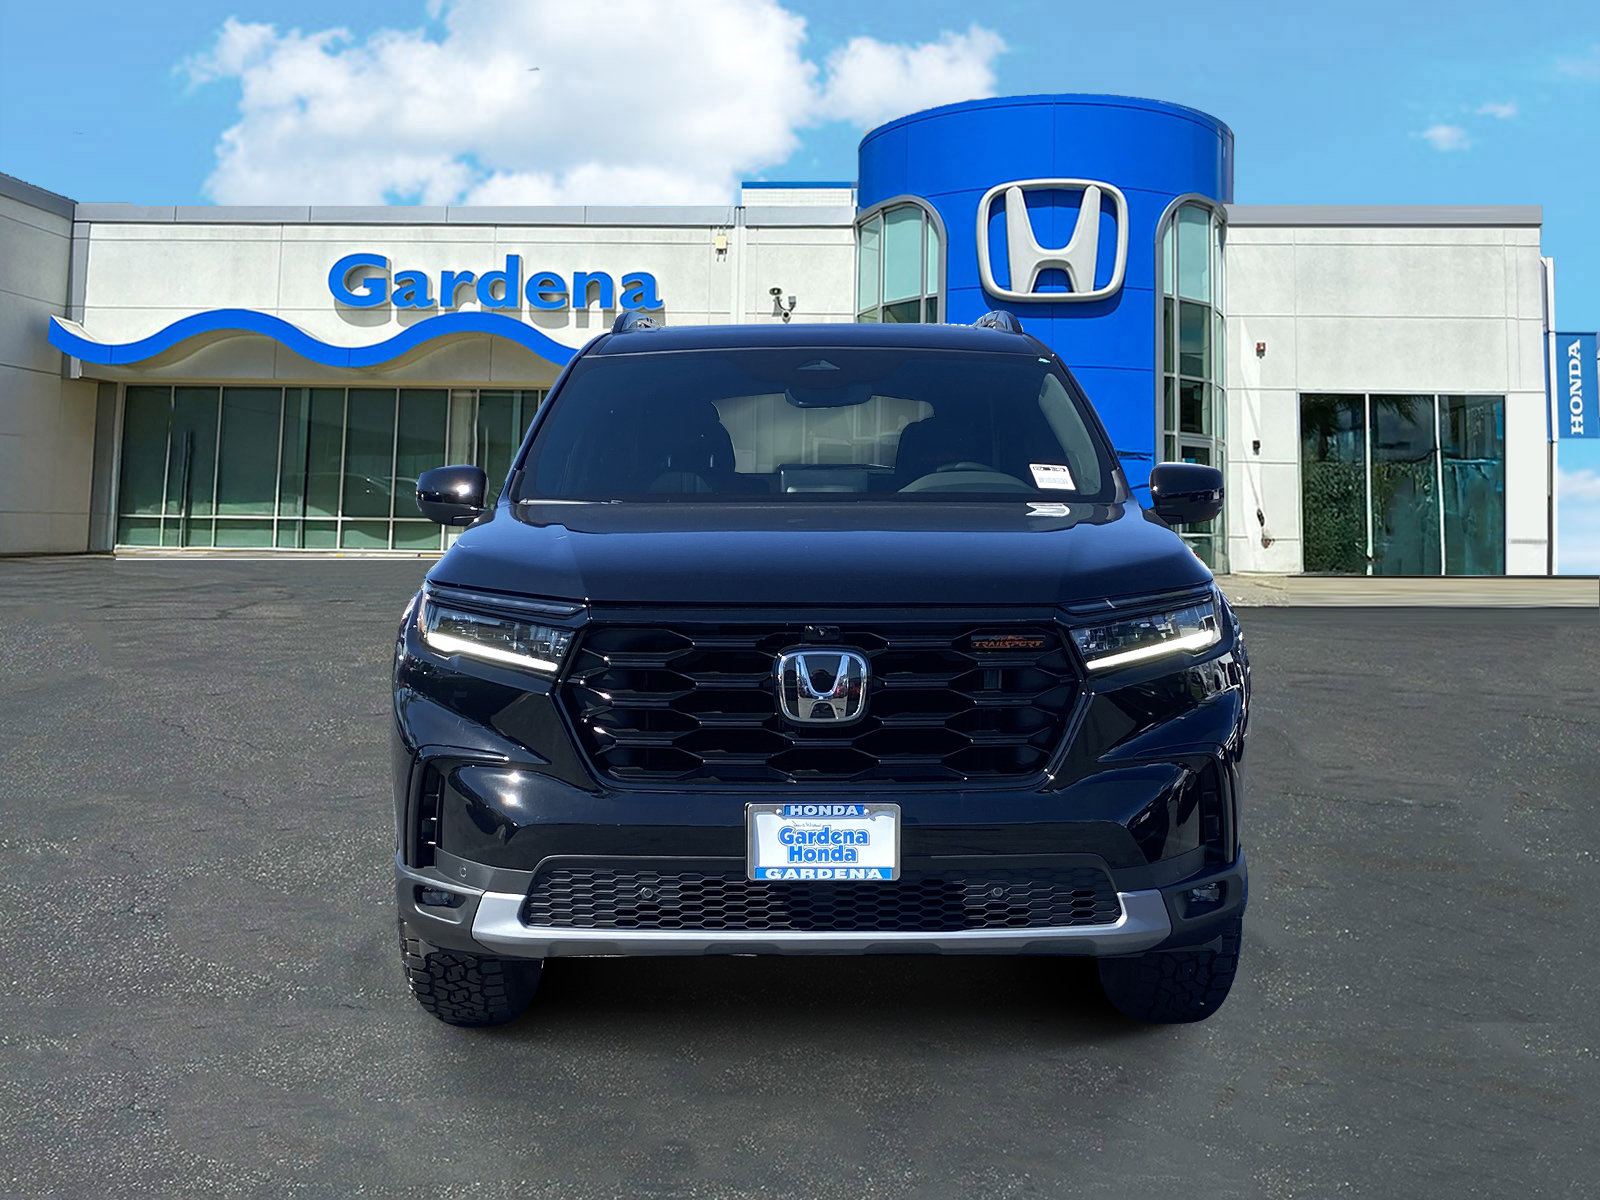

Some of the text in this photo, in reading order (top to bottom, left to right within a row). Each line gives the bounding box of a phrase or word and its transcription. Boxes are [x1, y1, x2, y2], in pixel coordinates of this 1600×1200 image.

[328, 252, 664, 309] Gardena
[1568, 339, 1584, 435] HONDA
[972, 640, 1043, 649] TRAILSPORT
[790, 805, 858, 816] HONDA
[779, 826, 869, 845] Gardena
[788, 845, 858, 863] Honda
[765, 868, 883, 880] GARDENA
